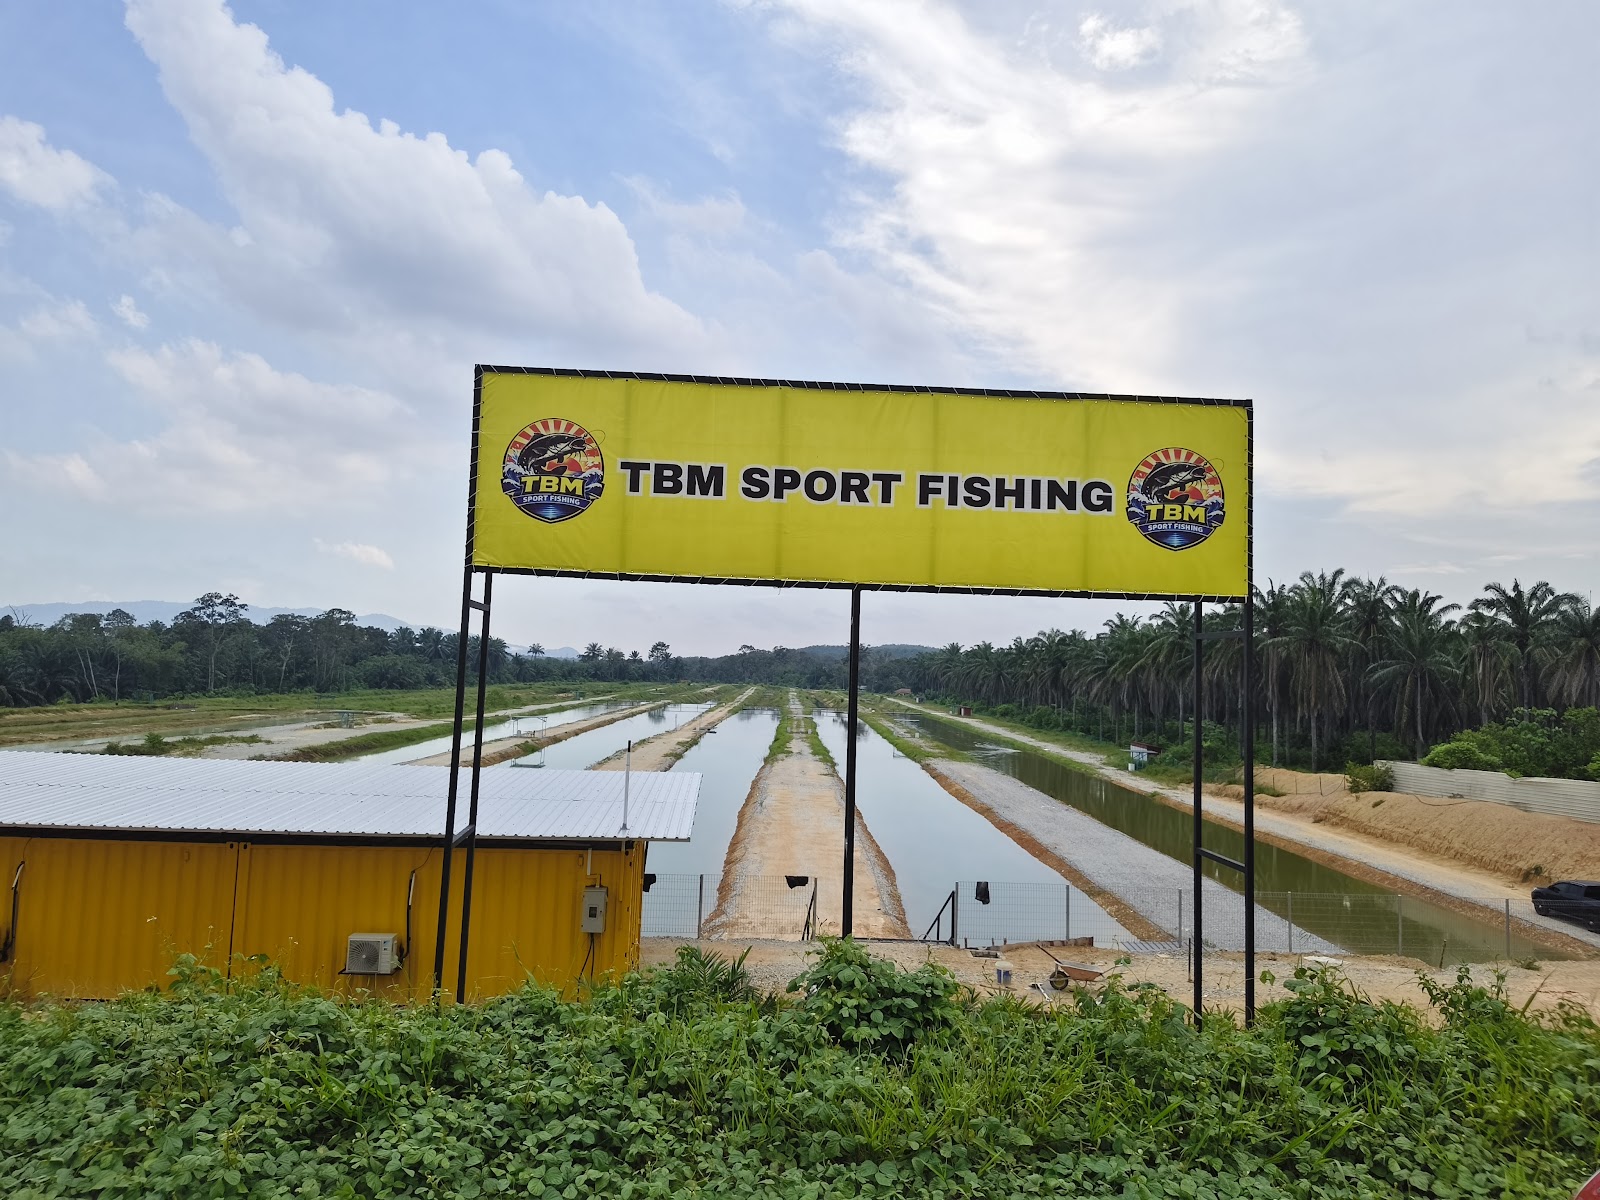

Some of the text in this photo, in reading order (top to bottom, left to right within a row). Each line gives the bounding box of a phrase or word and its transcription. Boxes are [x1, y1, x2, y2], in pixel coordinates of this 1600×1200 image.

[521, 475, 584, 495] TBM
[620, 461, 1113, 512] TBM SPORT FISHING
[522, 495, 581, 505] SPORT FISHING
[1146, 504, 1206, 523] TBM
[1147, 523, 1204, 533] SPORT FISHING
